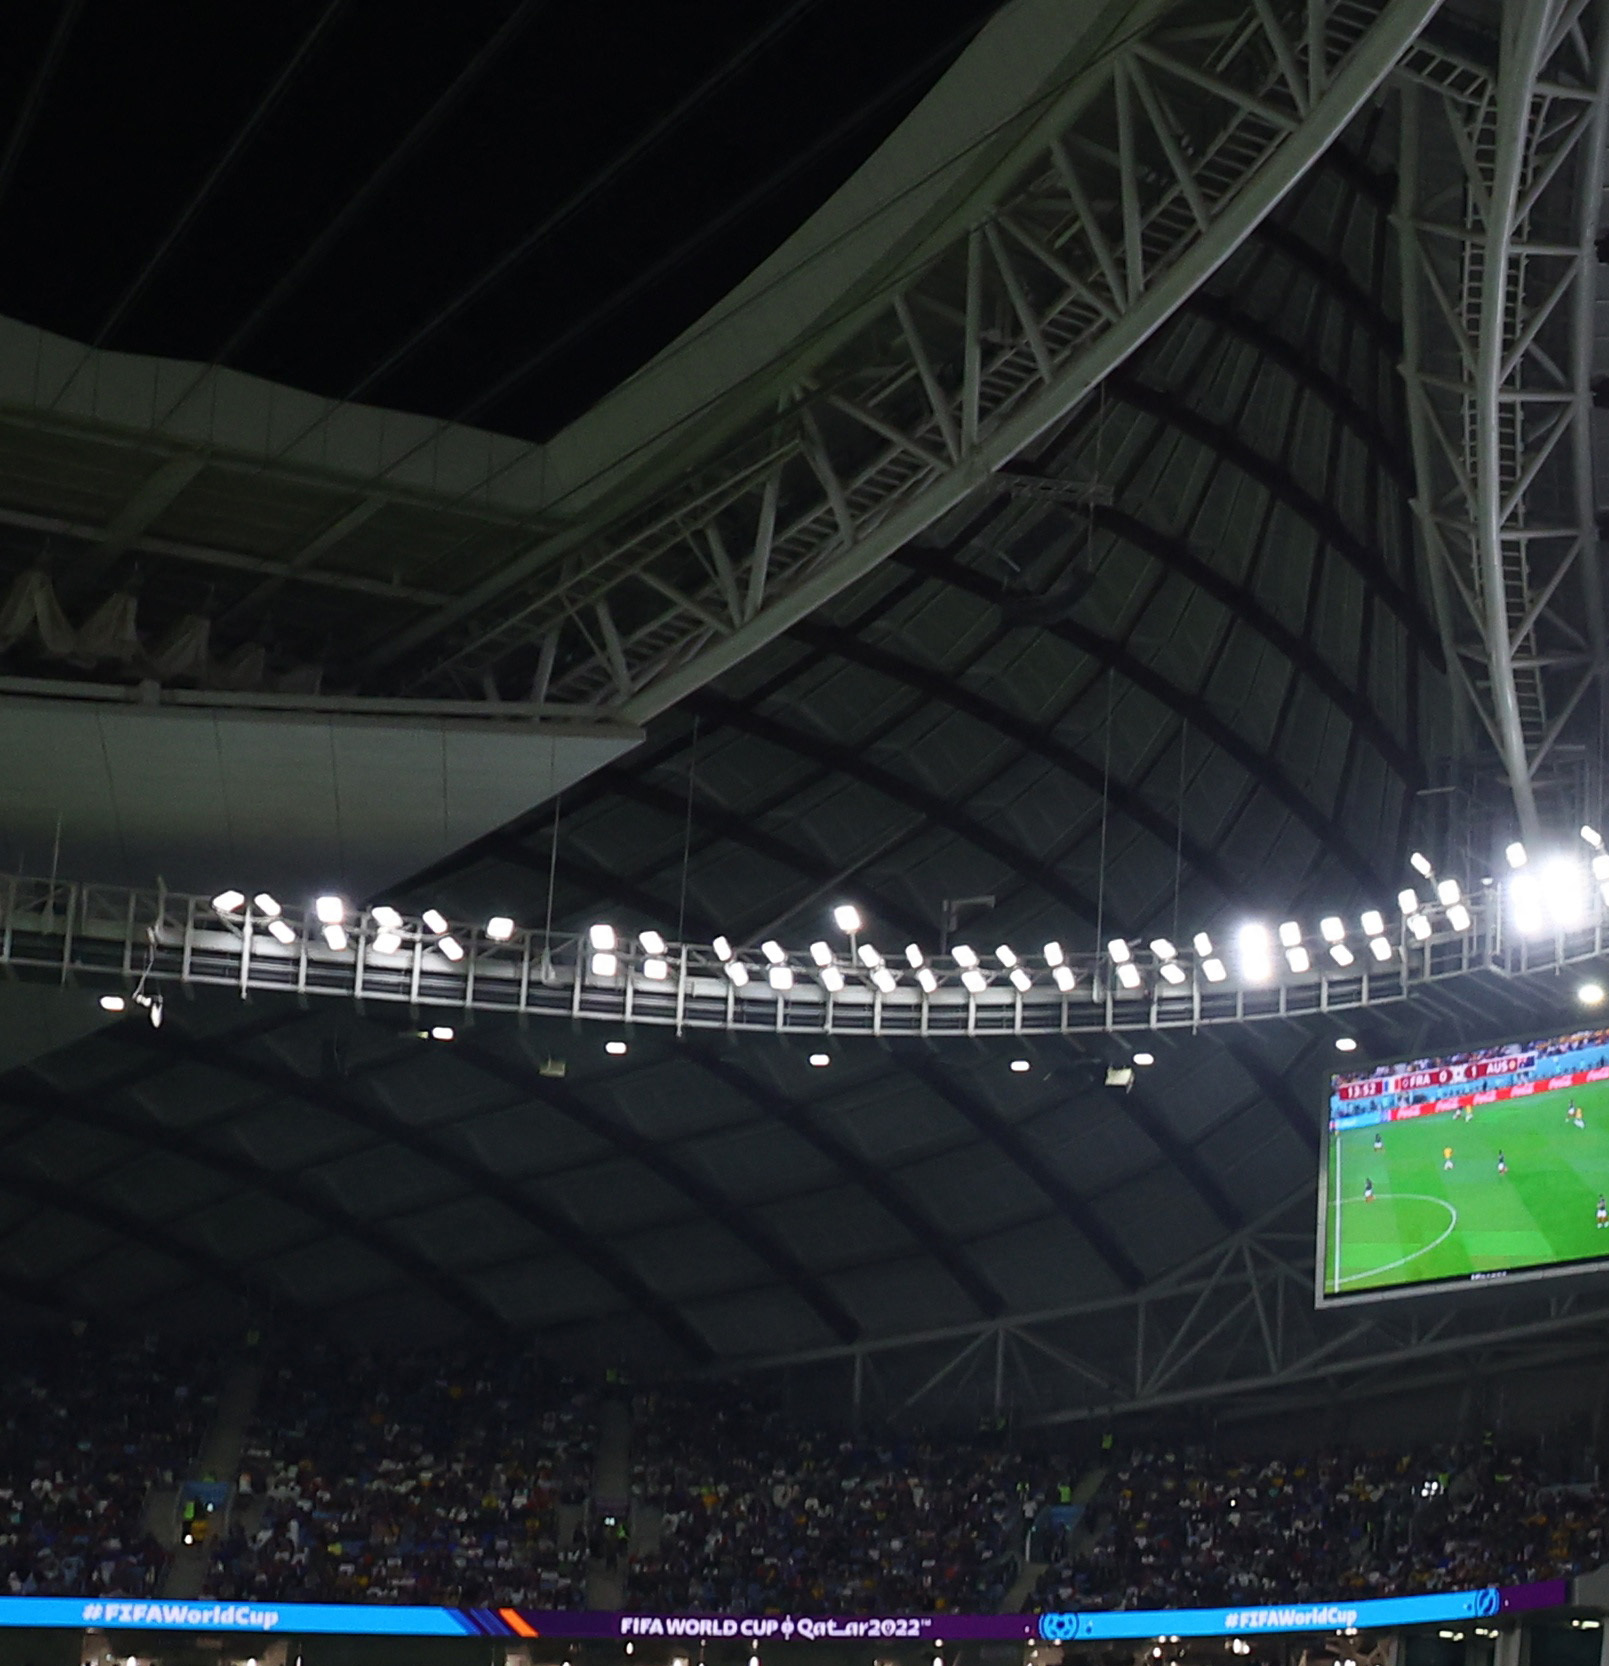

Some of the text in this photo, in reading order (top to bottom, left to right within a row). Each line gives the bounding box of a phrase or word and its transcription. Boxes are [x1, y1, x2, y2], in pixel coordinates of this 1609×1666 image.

[1409, 1074, 1431, 1088] FRA
[1486, 1059, 1508, 1075] AUS
[82, 1602, 279, 1630] #FIFAWorldCup
[621, 1616, 663, 1635] FIFA
[666, 1618, 738, 1636] WORLD
[740, 1619, 778, 1636] CUP
[1225, 1607, 1358, 1629] #FIFAWorldCup
